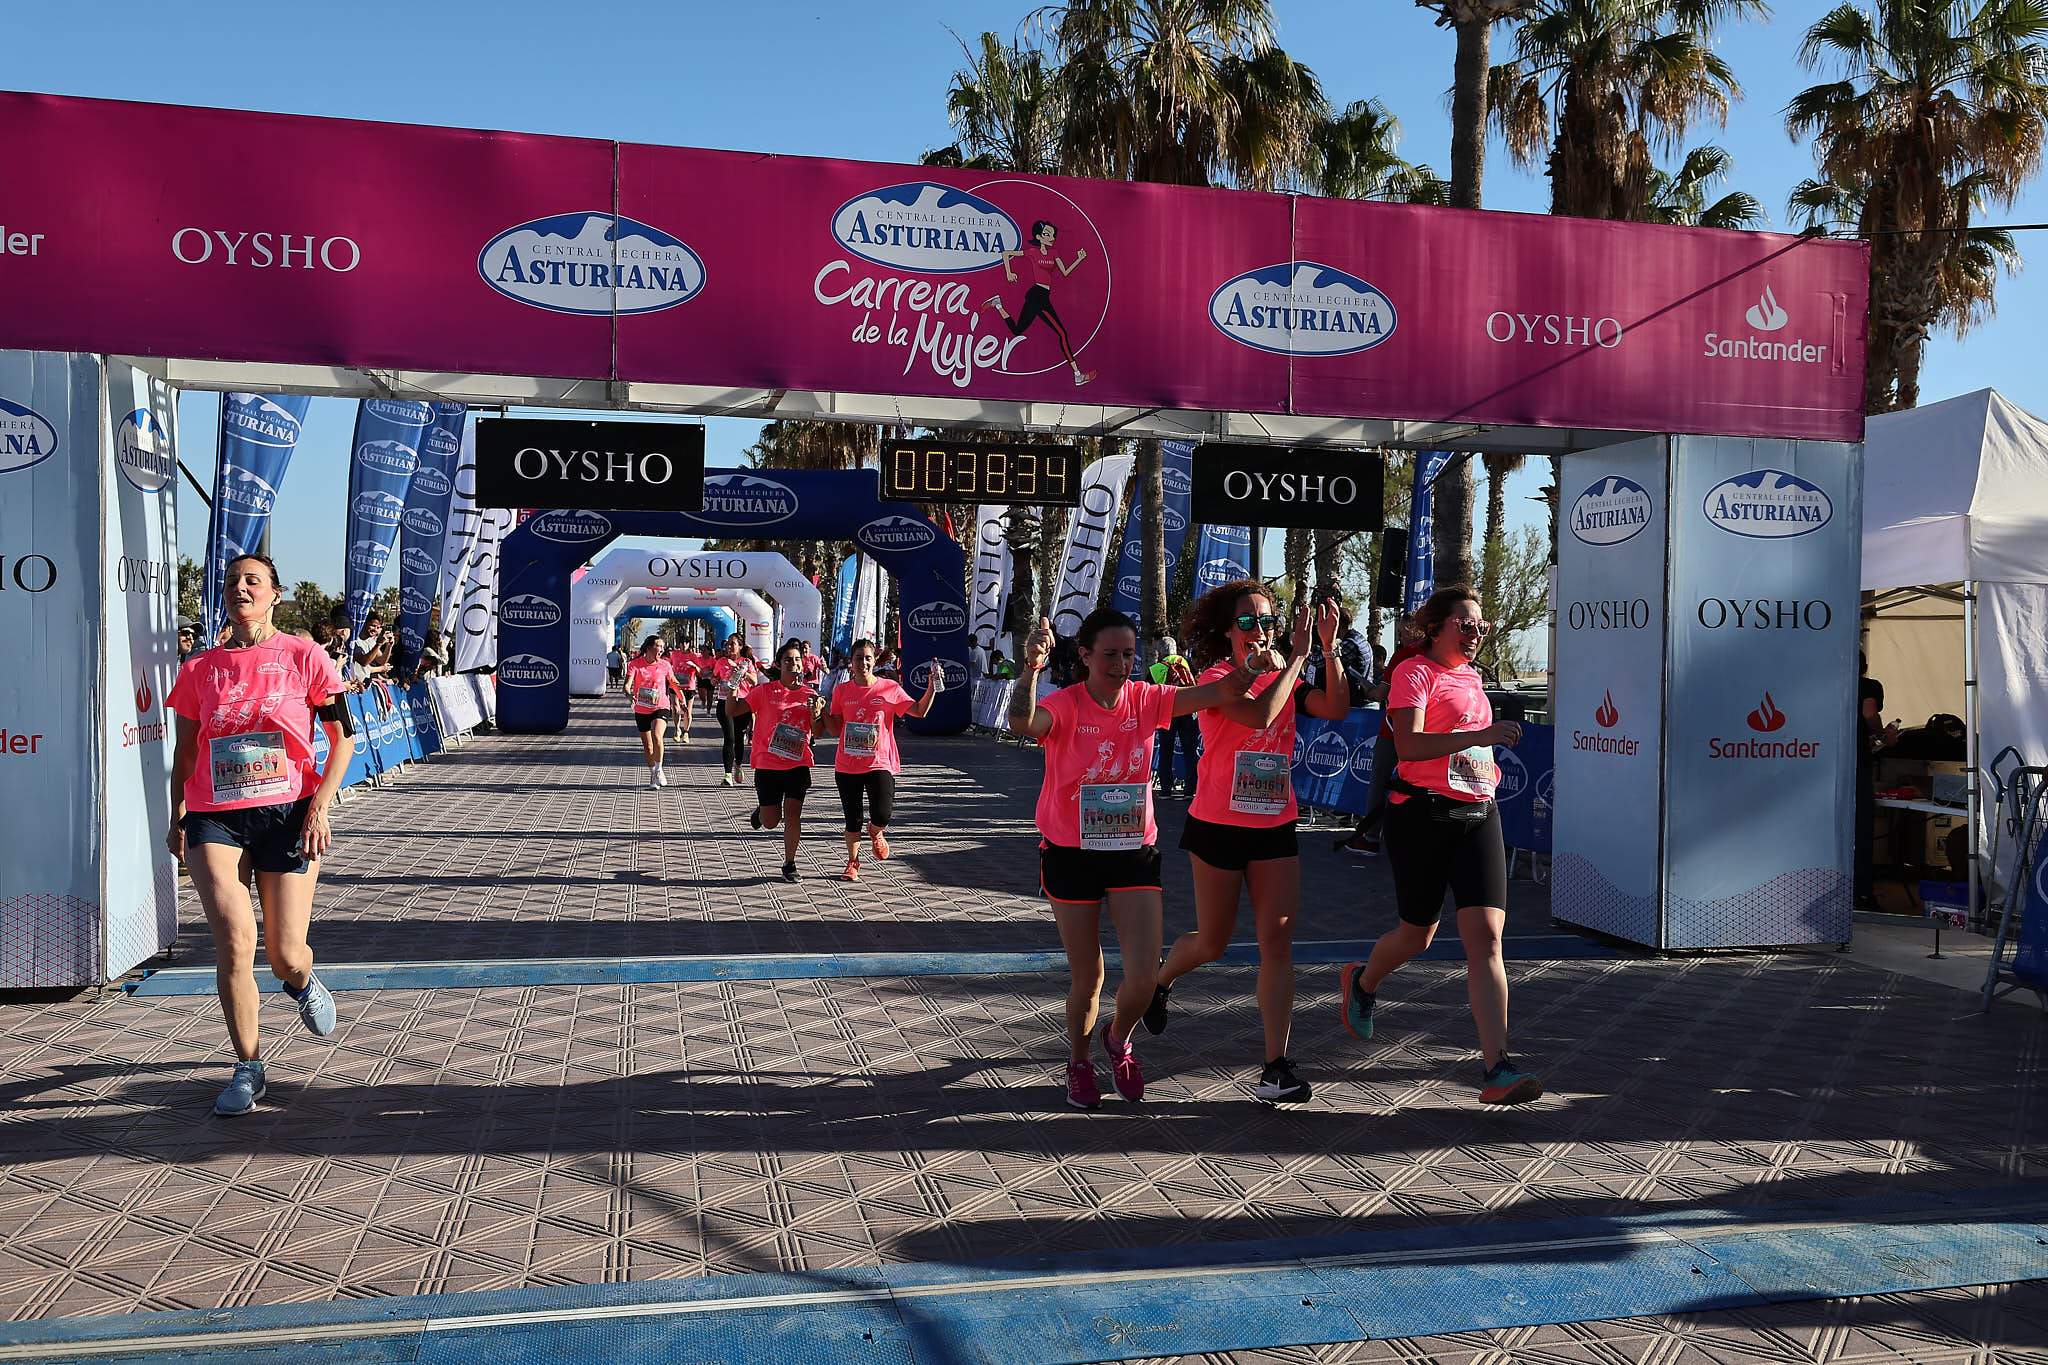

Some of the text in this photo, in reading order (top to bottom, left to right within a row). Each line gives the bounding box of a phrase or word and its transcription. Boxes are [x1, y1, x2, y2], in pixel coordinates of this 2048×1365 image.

[876, 209, 1001, 227] CENTRAL LECHERA
[847, 210, 1006, 254] ASTURIANA
[171, 227, 361, 272] OYSHO
[532, 244, 681, 262] CENTRAL LECHERA
[496, 244, 689, 291] ASTURIANA
[814, 260, 972, 315] Carrera
[1253, 291, 1378, 307] CENTRAL LECHERA
[1224, 292, 1382, 334] ASTURIANA
[1486, 311, 1624, 349] OYSHO
[852, 311, 1027, 388] de la Mujer
[1703, 332, 1828, 363] Santander
[513, 447, 673, 485] OYSHO
[895, 450, 1066, 495] 00:38:34
[1223, 470, 1357, 505] OYSHO
[1732, 491, 1773, 501] CENTRAL
[1574, 504, 1646, 532] ASTURIANA
[1711, 493, 1823, 522] ASTURIANA
[536, 519, 606, 535] ASTURIANA
[864, 529, 931, 543] ASTURIANA
[118, 555, 171, 596] OYSHO
[647, 557, 747, 579] OYSHO
[587, 578, 618, 586] OYSHO
[775, 580, 804, 588] OYSHO
[502, 606, 558, 621] ASTURIANA
[573, 618, 602, 626] OYSHO
[789, 620, 817, 629] OYSHO
[911, 613, 963, 626] ASTURIANA
[1568, 598, 1649, 630] OYSHO
[1697, 597, 1832, 631] OYSHO
[500, 664, 555, 680] ASTURIANA
[571, 657, 601, 666] OYSHO
[1573, 730, 1639, 756] Santander
[1708, 737, 1820, 759] Santander
